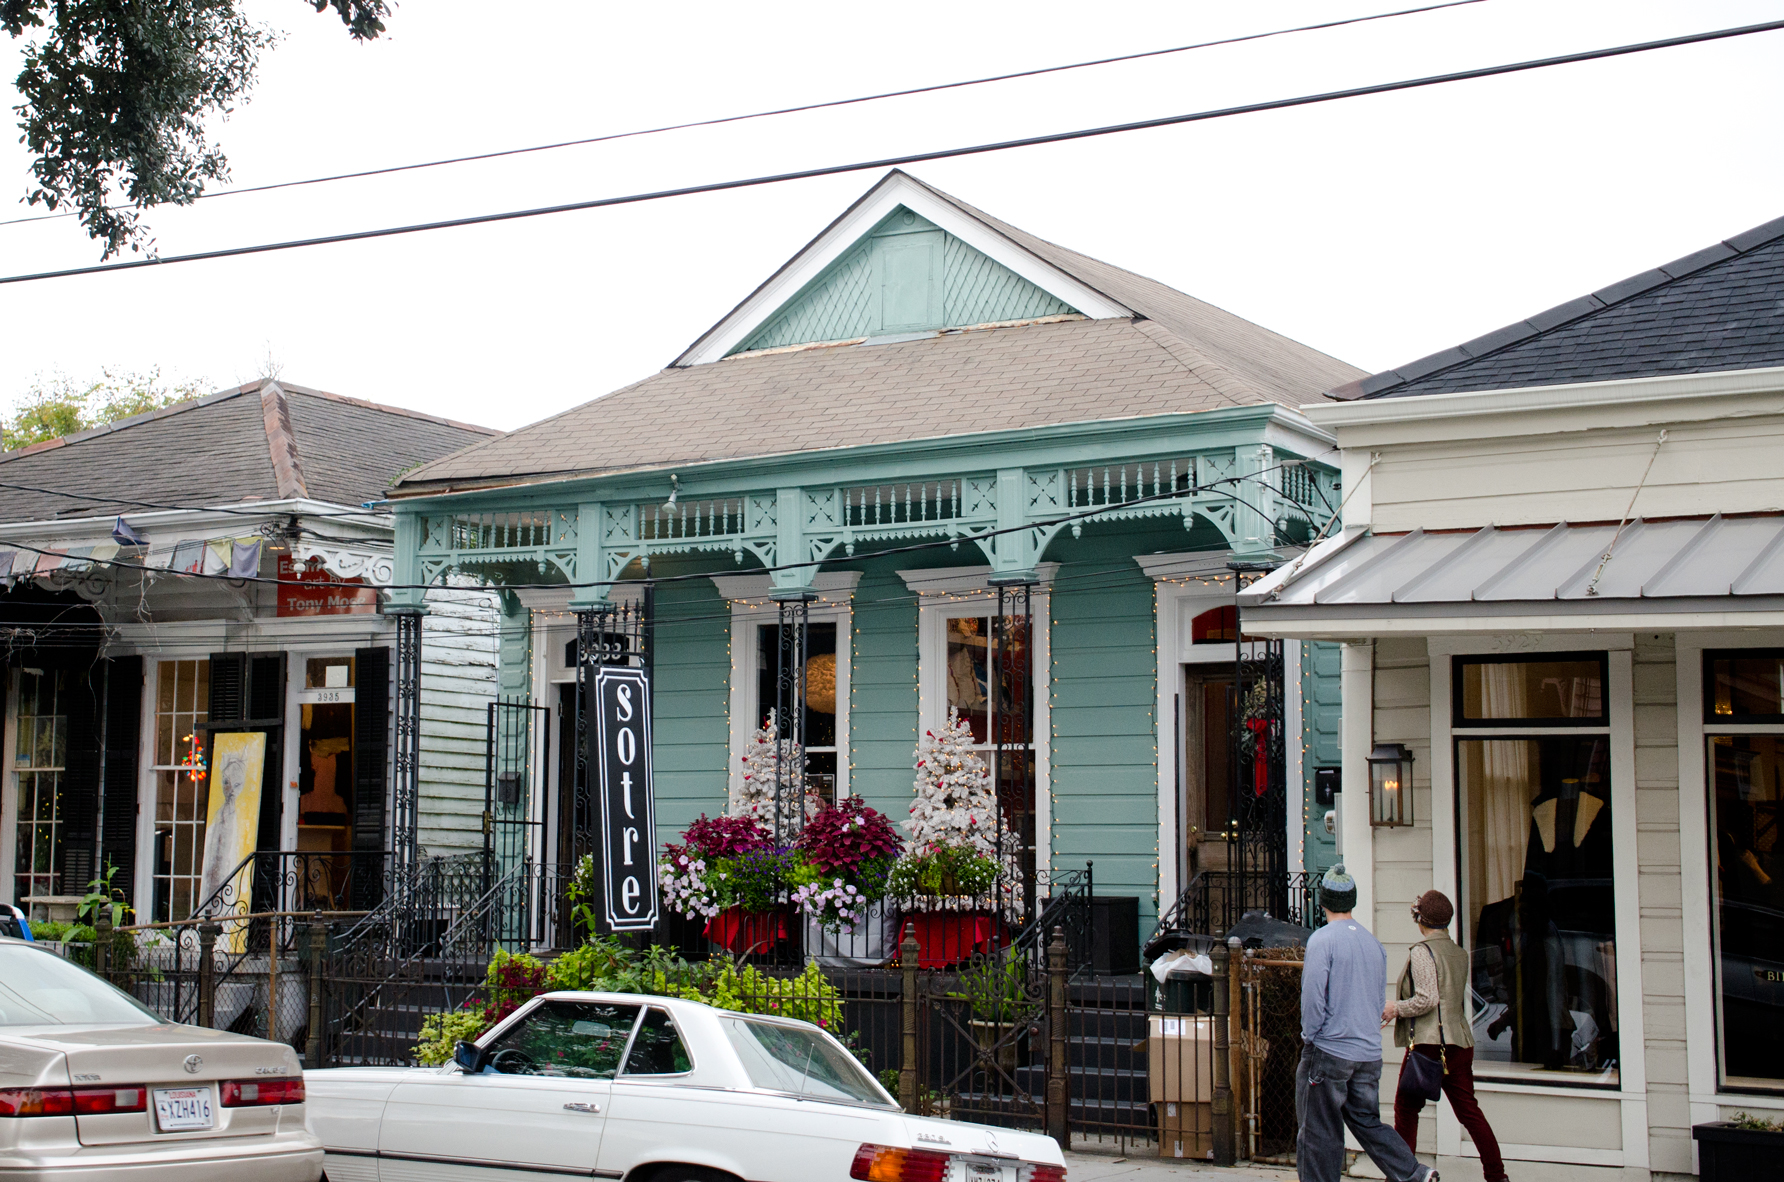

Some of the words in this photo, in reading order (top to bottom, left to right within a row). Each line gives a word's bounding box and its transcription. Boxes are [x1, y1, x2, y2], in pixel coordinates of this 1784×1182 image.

[287, 598, 323, 613] Tony
[317, 692, 340, 702] 3935
[169, 1091, 197, 1099] LOUISIANA
[168, 1100, 210, 1118] XZH416
